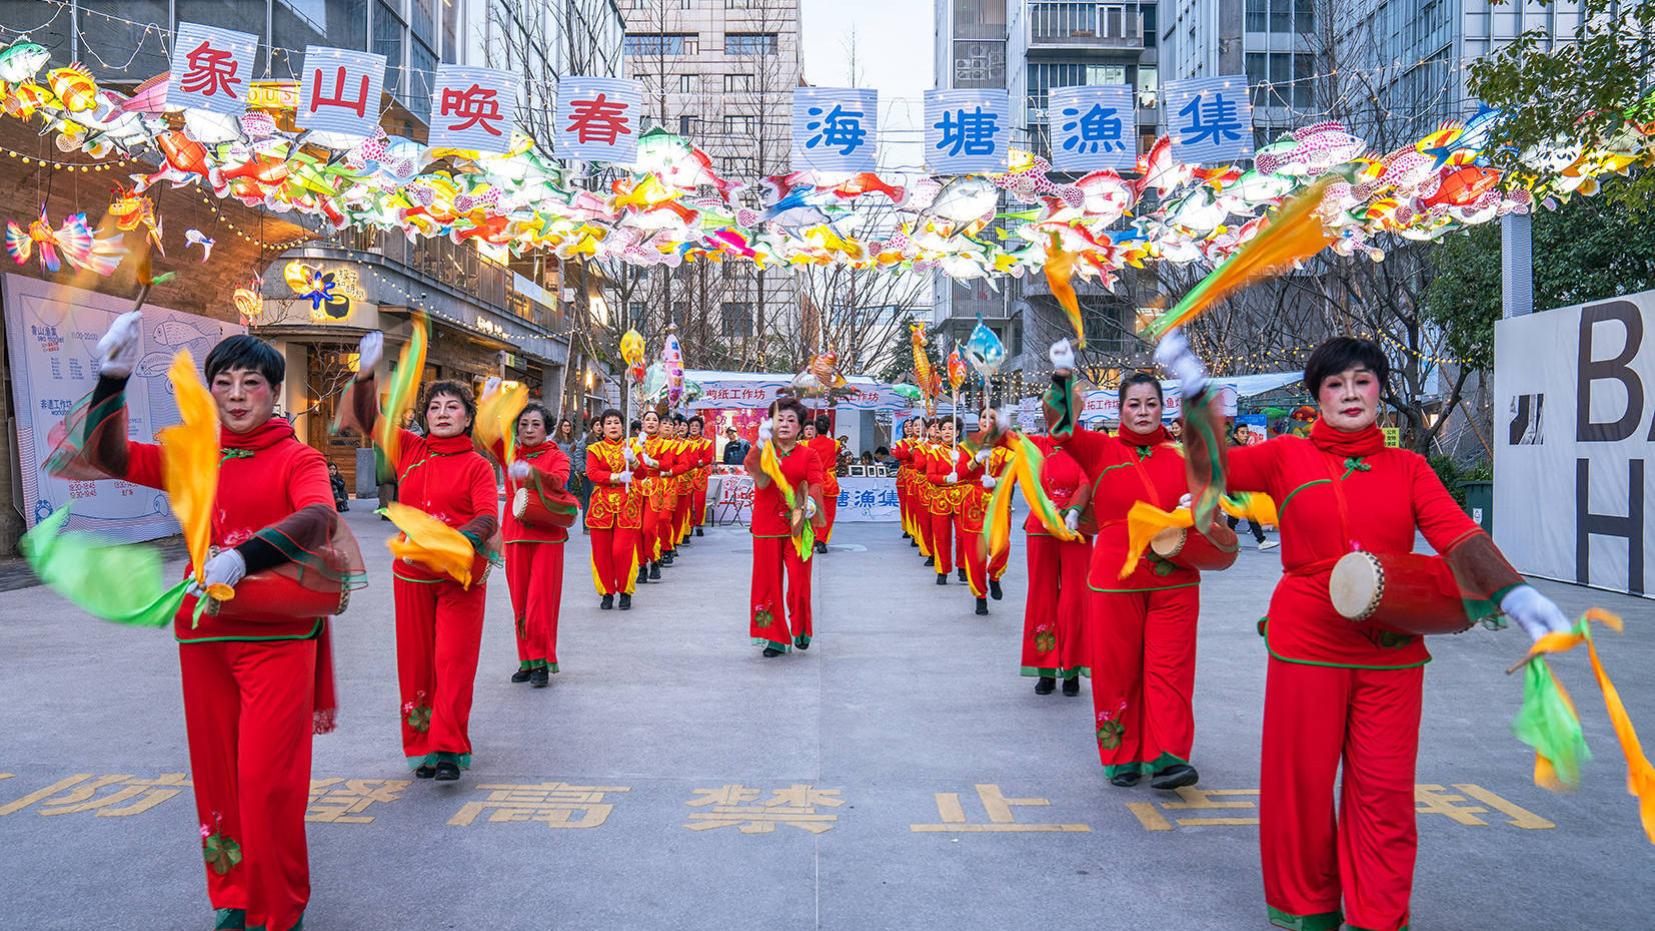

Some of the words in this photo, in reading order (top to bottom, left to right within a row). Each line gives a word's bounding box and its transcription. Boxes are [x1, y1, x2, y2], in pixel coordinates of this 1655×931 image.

[179, 38, 633, 147] 象山唤春
[1577, 299, 1655, 443] B
